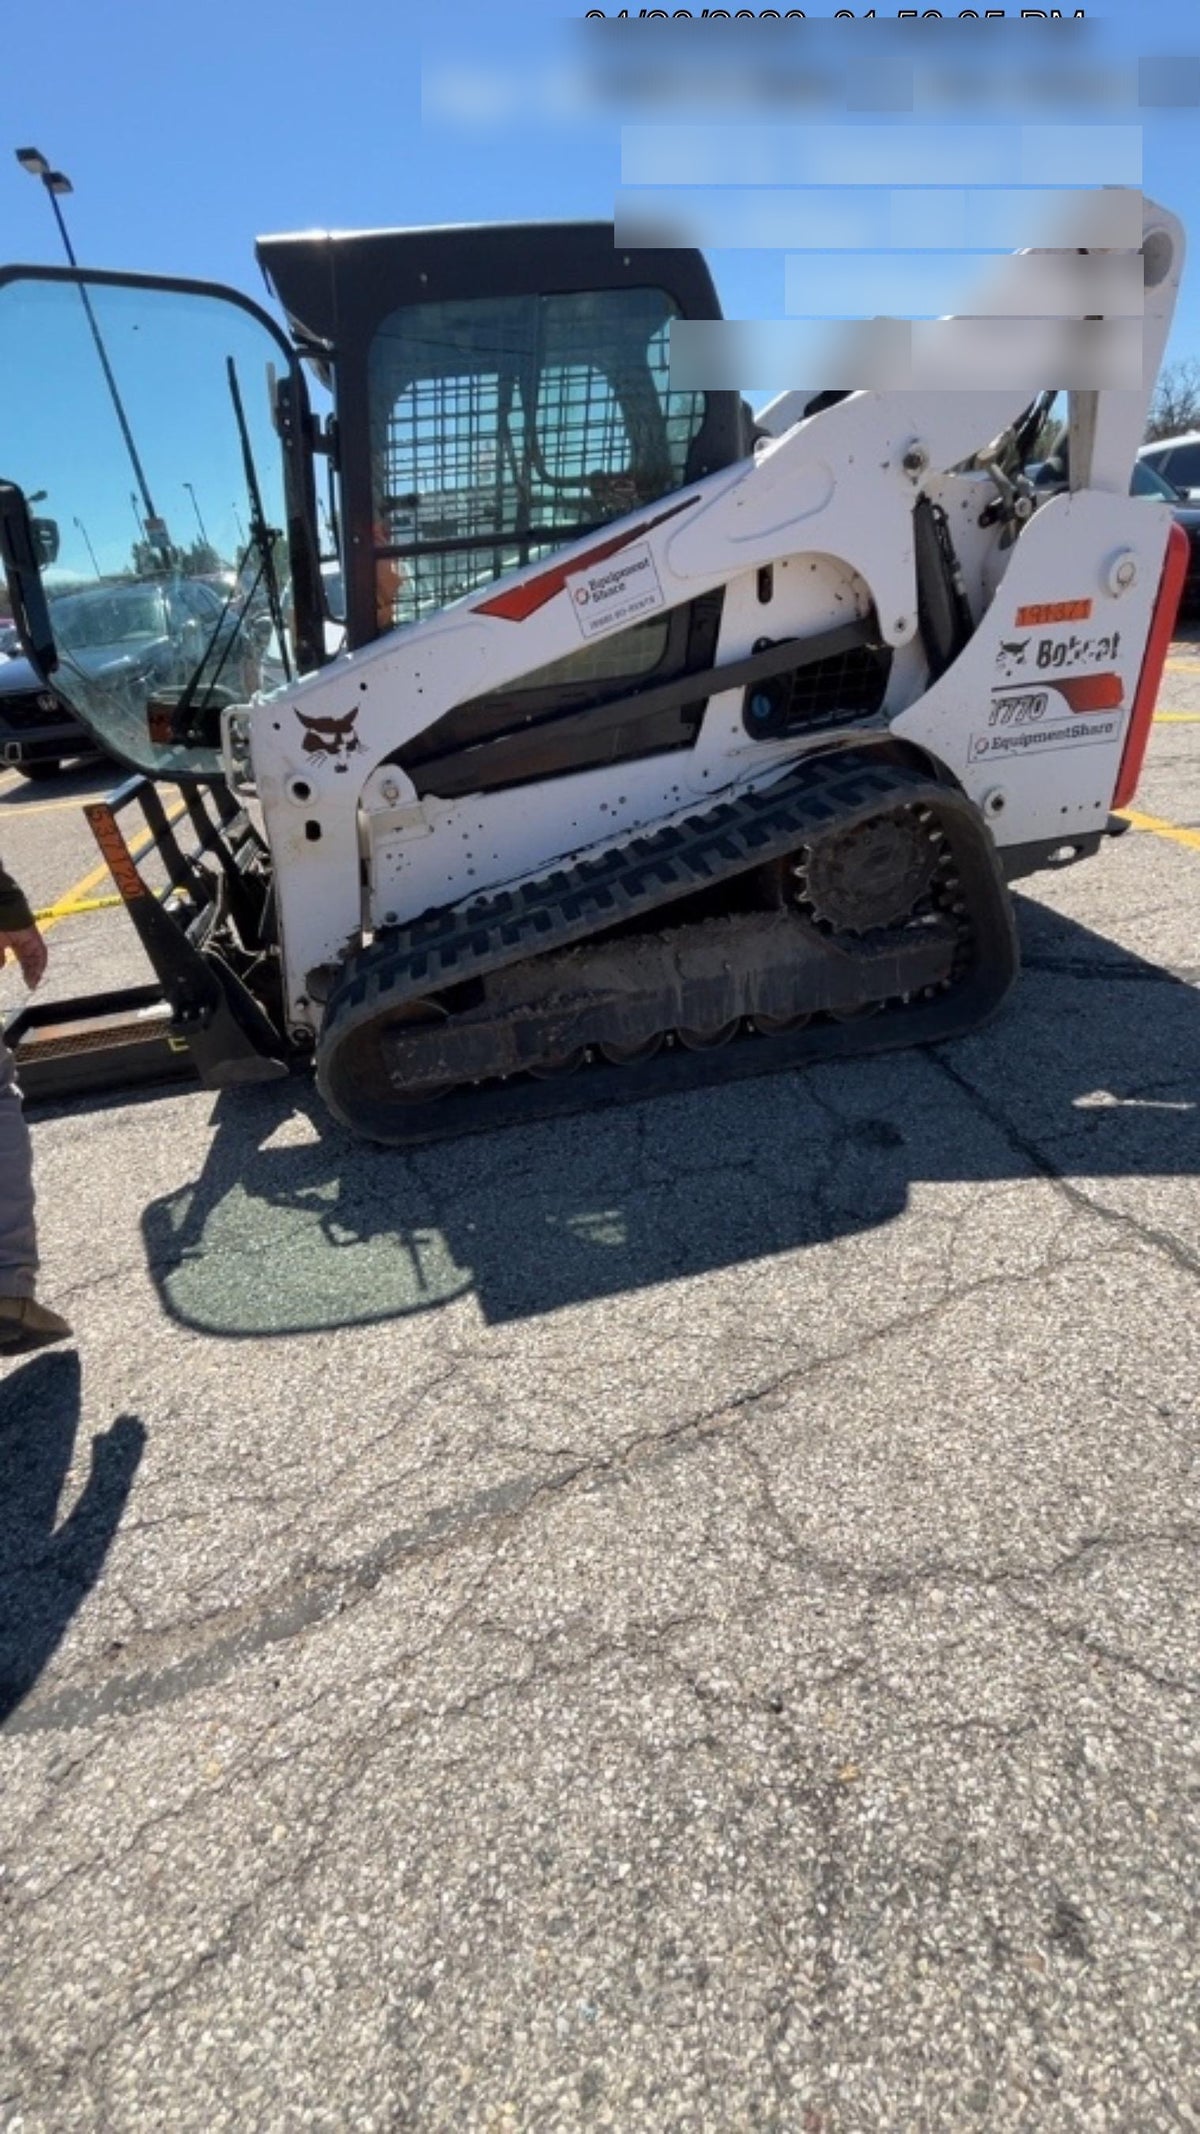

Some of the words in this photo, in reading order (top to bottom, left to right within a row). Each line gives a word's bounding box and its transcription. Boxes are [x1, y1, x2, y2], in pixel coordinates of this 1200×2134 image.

[588, 557, 651, 591] Equipment
[592, 582, 627, 603] Share
[991, 722, 1114, 751] EquipmentShare
